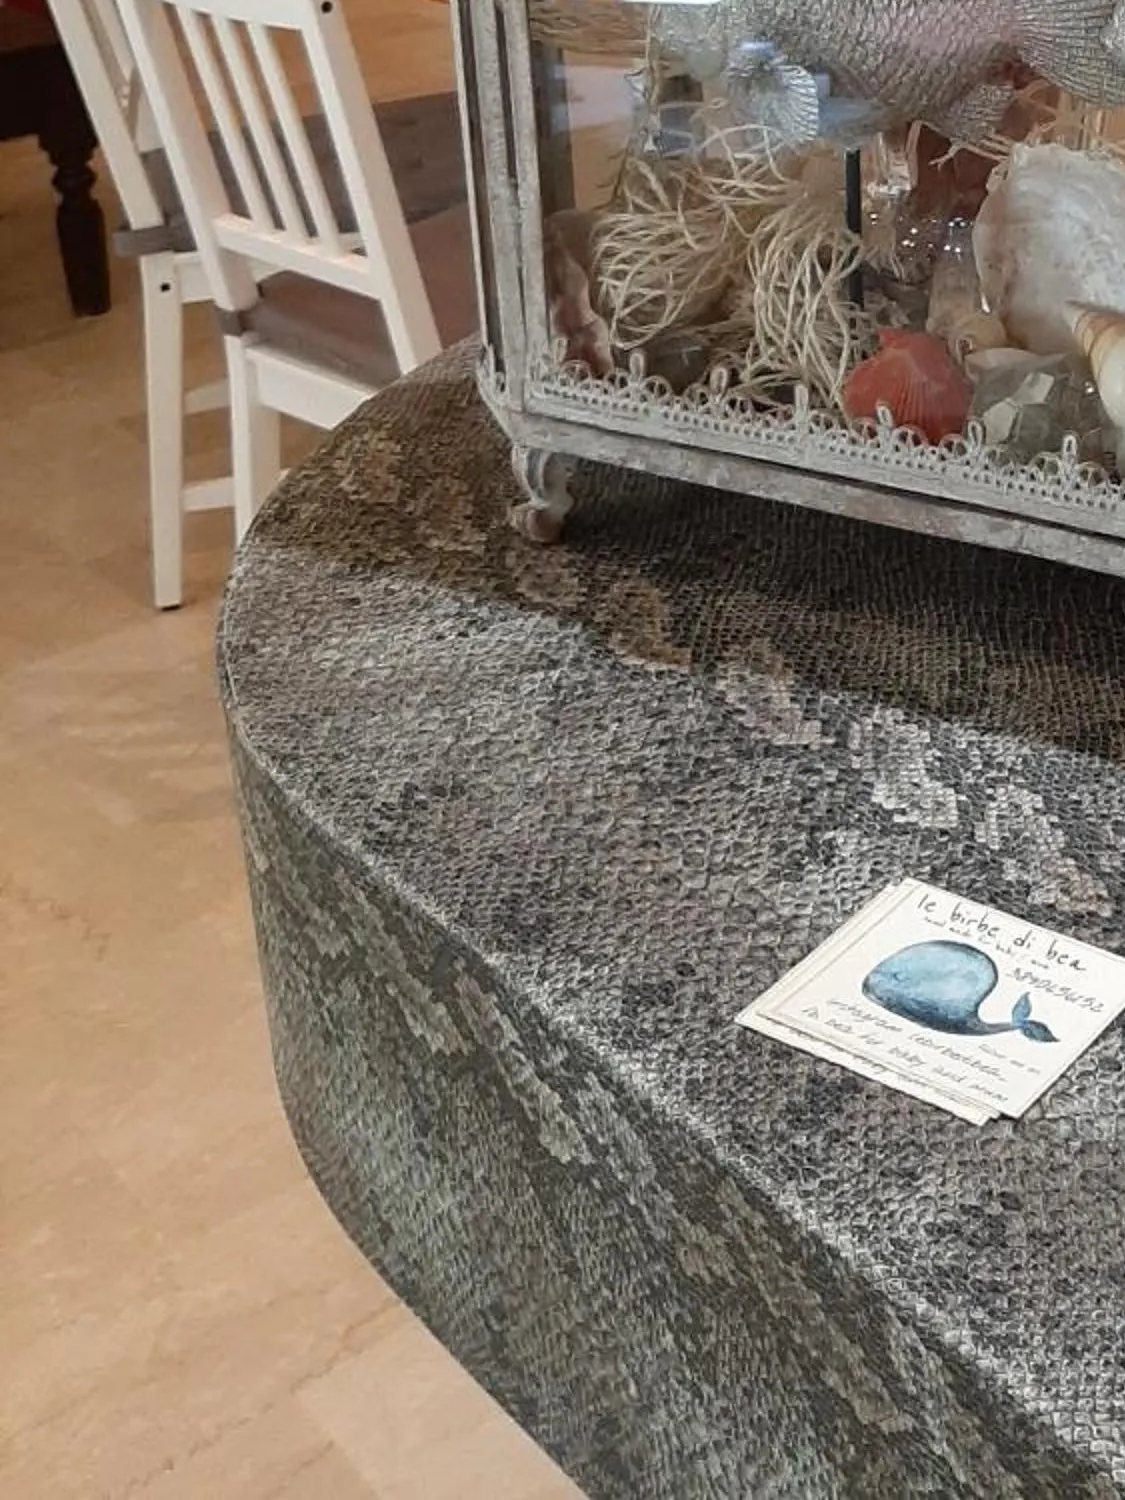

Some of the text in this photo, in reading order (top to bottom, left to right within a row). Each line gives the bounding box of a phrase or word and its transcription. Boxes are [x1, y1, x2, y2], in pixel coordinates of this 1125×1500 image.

[917, 894, 938, 913] le
[951, 901, 1001, 937] birbe
[1013, 929, 1037, 949] di
[1046, 938, 1087, 971] bea
